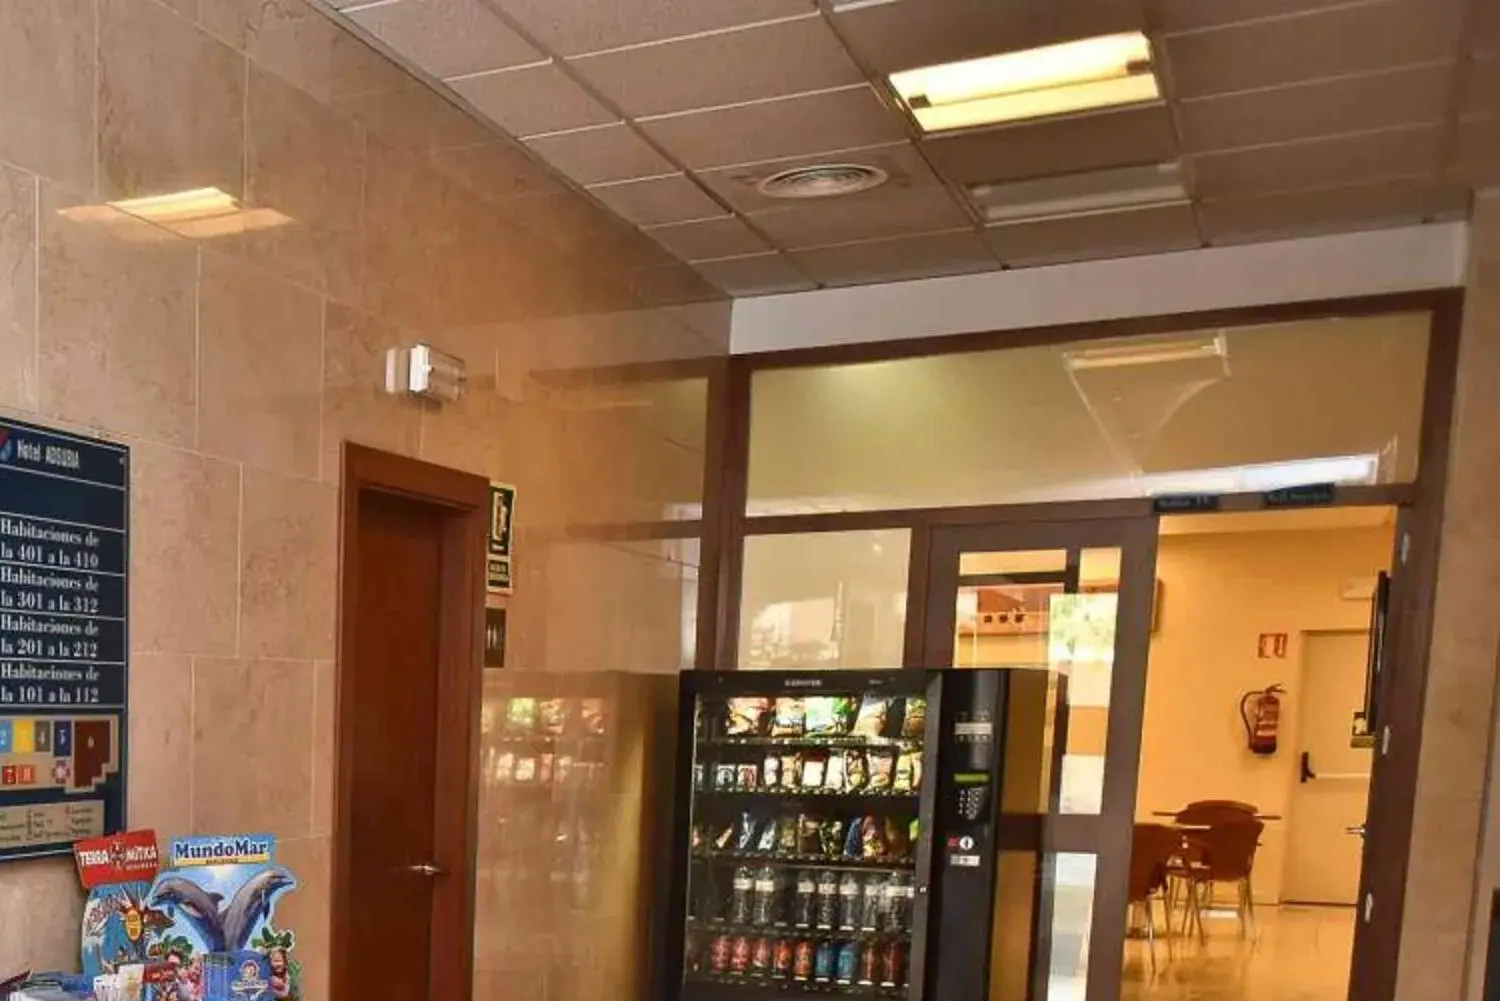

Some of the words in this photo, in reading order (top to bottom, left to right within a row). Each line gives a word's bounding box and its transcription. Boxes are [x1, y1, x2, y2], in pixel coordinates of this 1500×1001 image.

[1, 517, 82, 544] Habitaciones
[85, 531, 100, 547] de
[1, 541, 14, 559] la
[17, 544, 42, 562] 401
[48, 553, 56, 564] a
[59, 549, 71, 566] la
[74, 551, 99, 568] 410
[1, 566, 82, 590] Habitaciones
[85, 576, 99, 592] de
[1, 590, 13, 607] la
[17, 592, 42, 610] 301
[49, 600, 56, 611] a
[59, 595, 70, 611] la
[73, 597, 99, 613] 312
[1, 614, 82, 635] Habitaciones
[85, 620, 99, 636] de
[1, 638, 14, 654] la
[17, 638, 42, 656] 201
[48, 646, 55, 657] a
[59, 641, 70, 657] la
[73, 641, 97, 657] 212
[1, 663, 82, 680] Habitaciones
[85, 666, 99, 681] de
[1, 686, 13, 702] la
[19, 686, 44, 703] 101
[59, 687, 71, 703] la
[76, 687, 99, 703] 112
[175, 840, 268, 859] MundoMar
